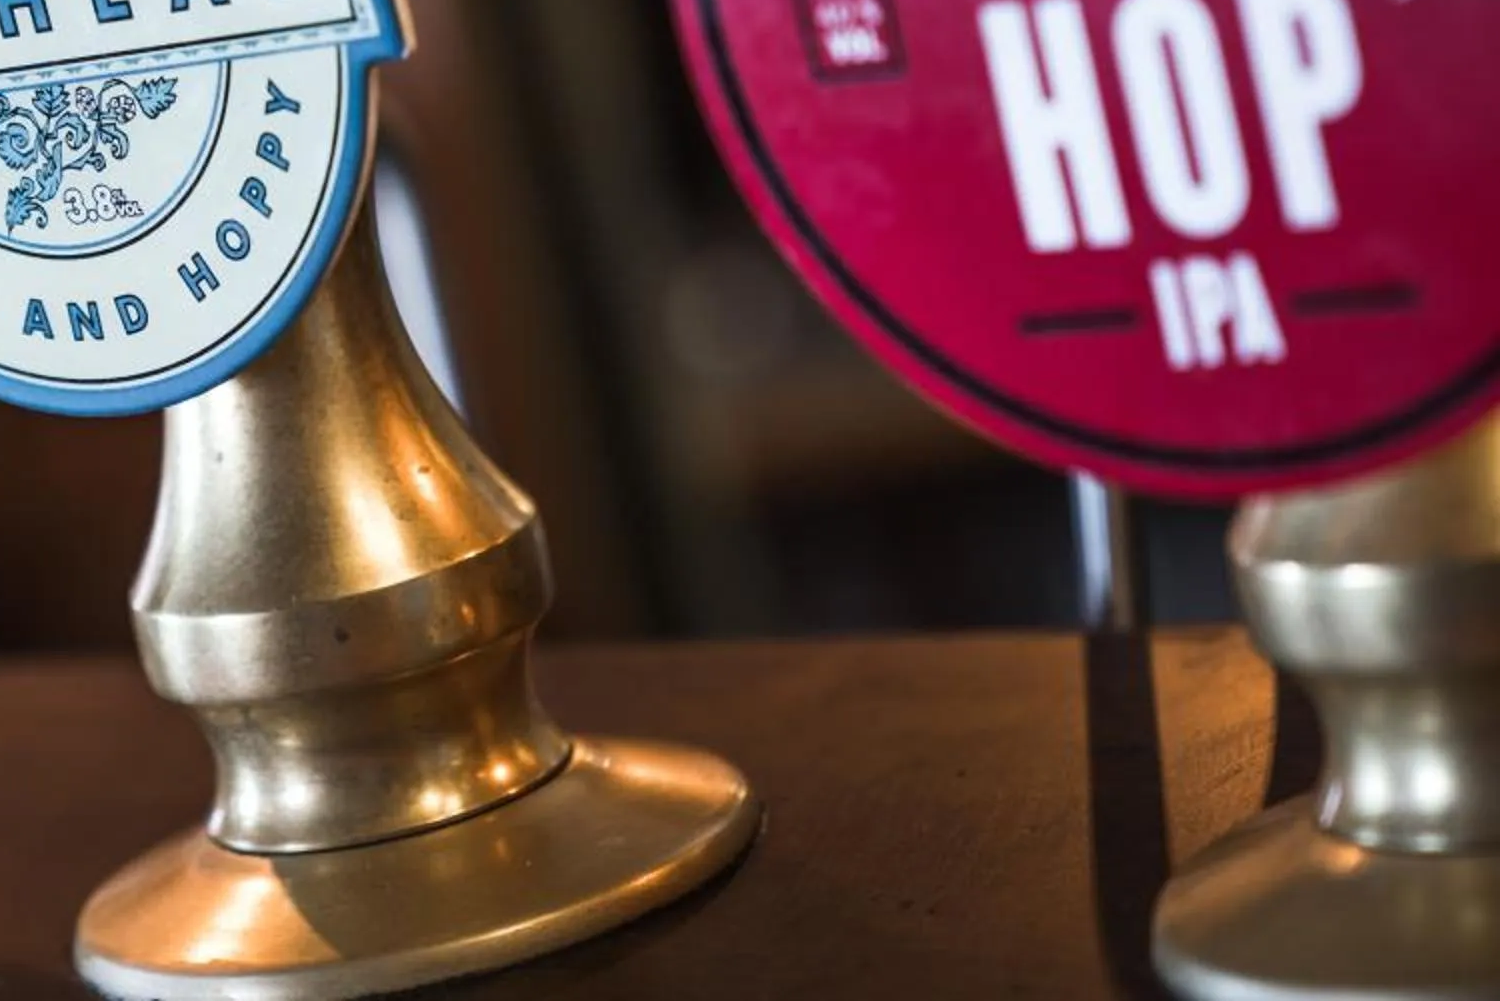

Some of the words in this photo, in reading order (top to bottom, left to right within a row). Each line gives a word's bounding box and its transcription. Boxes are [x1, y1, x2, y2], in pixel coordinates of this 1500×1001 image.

[21, 293, 150, 342] AND
[177, 77, 303, 303] HOPPY
[1148, 250, 1288, 370] IPA
